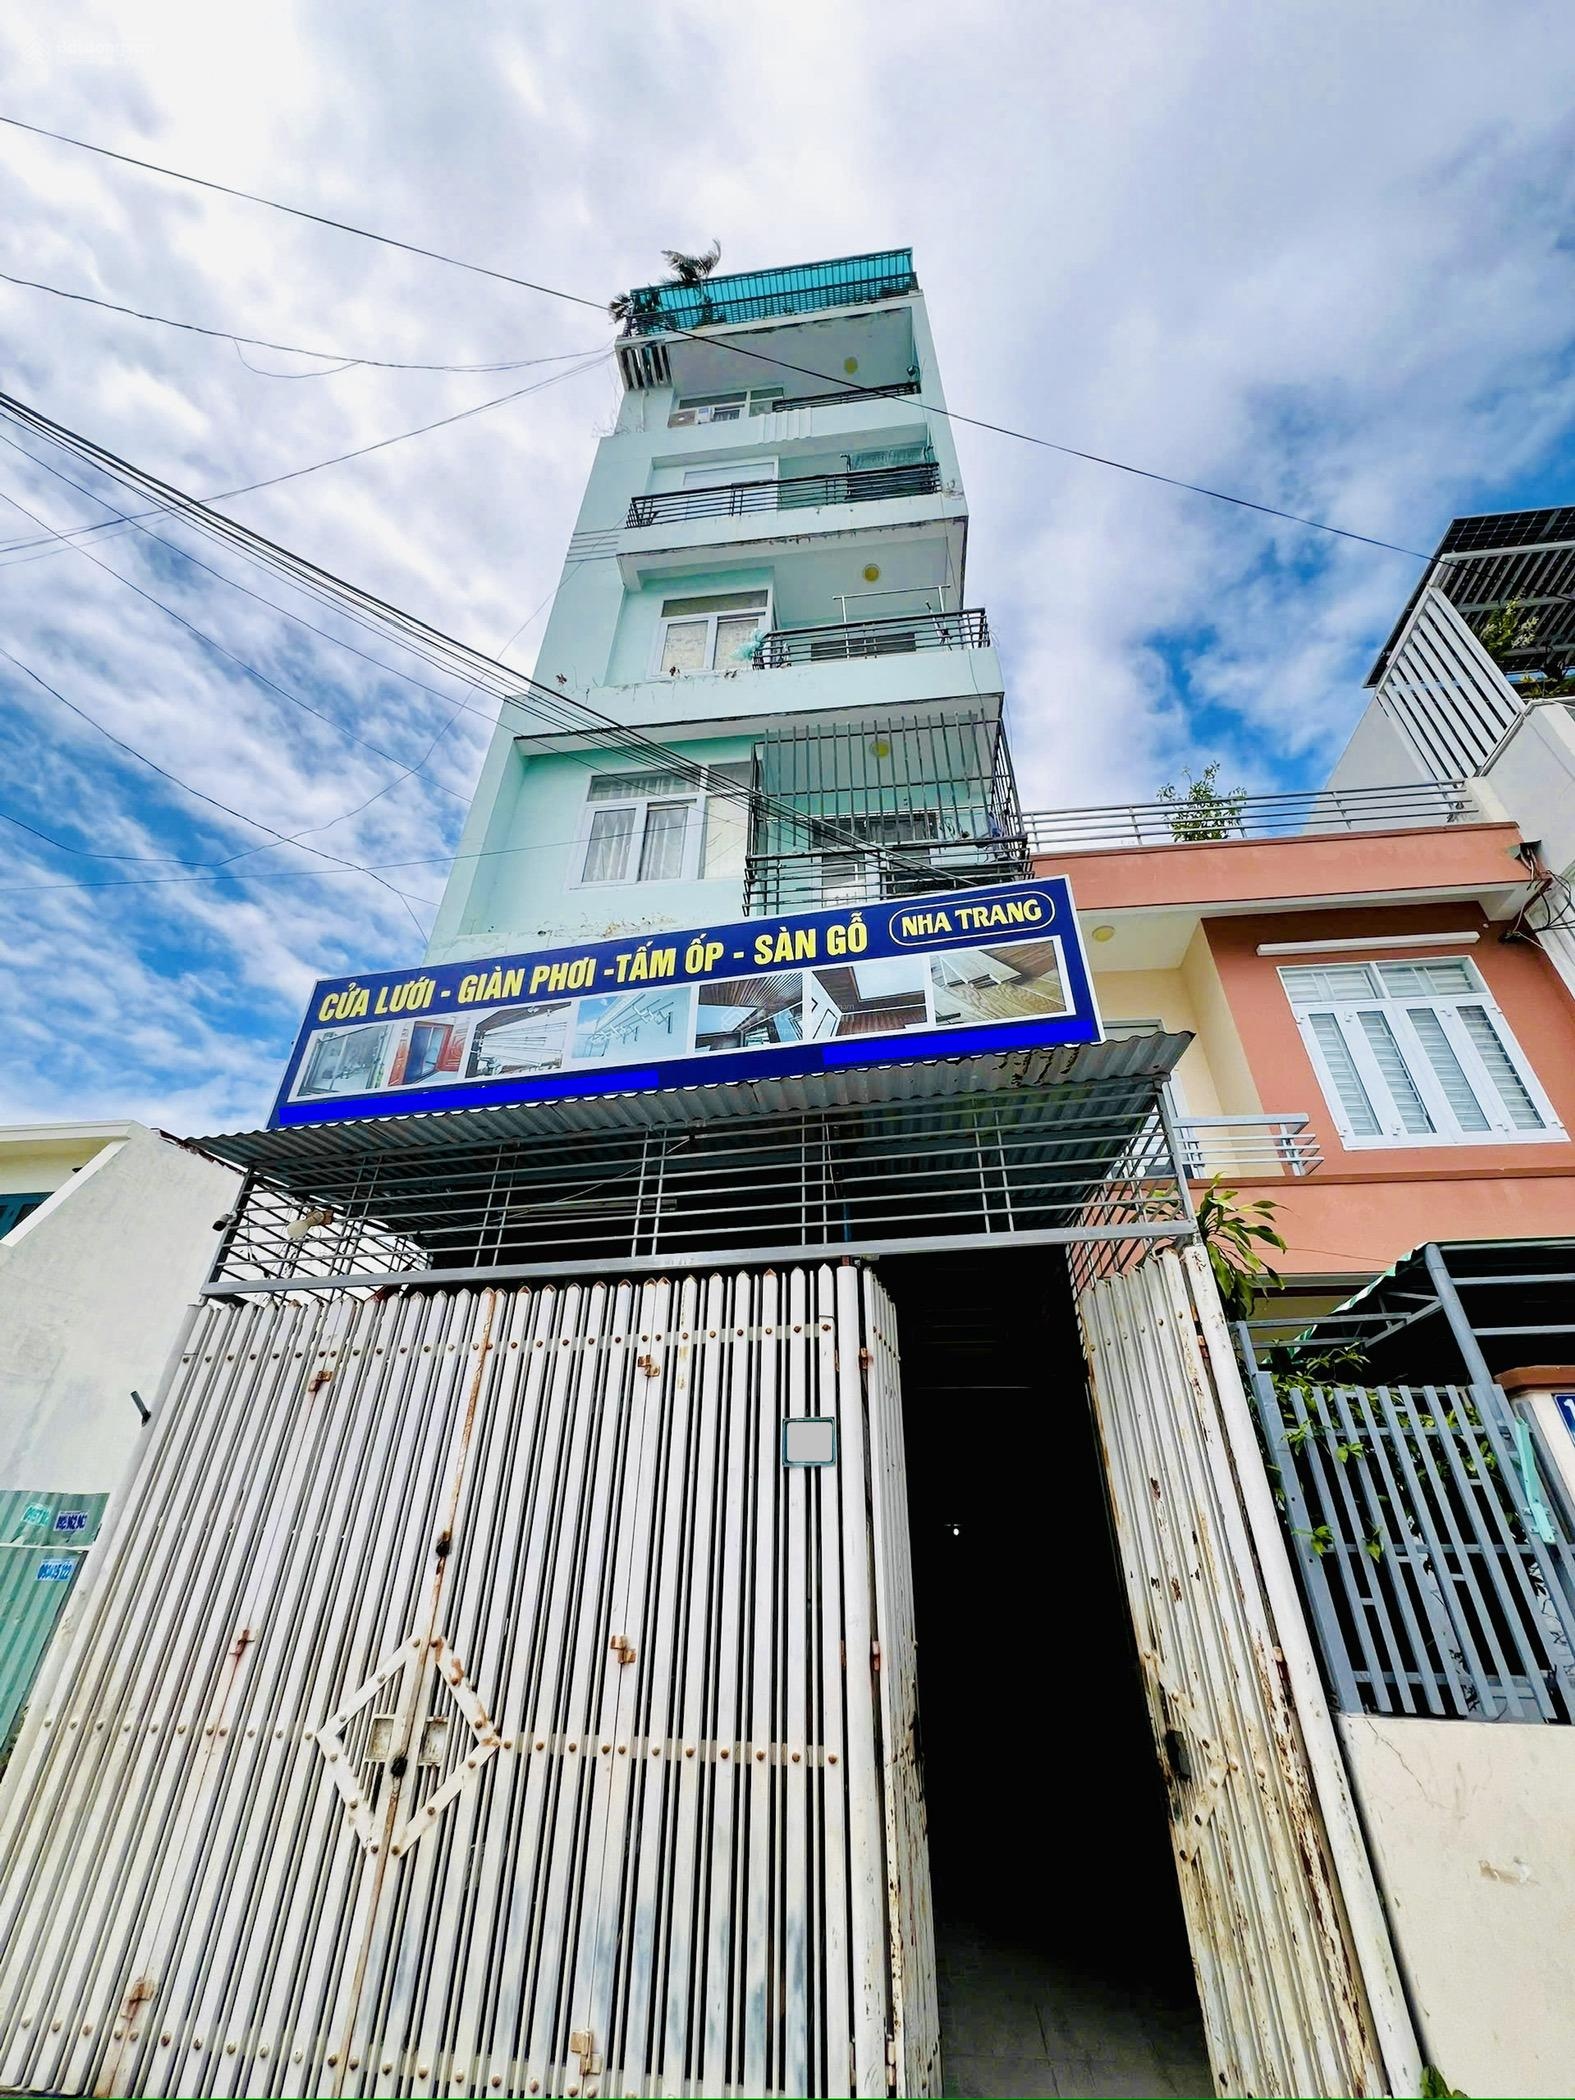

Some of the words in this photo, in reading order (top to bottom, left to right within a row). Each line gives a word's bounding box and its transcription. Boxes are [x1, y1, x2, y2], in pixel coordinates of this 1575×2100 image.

[901, 912, 953, 938] NHA
[955, 899, 1042, 931] TRANG
[318, 982, 369, 1022] CỬA
[374, 977, 436, 1015] LƯỚI
[458, 966, 526, 1004] GIÀN
[530, 958, 597, 995] PHƠI
[685, 933, 724, 974] ỐP
[754, 927, 817, 965] SÀN
[826, 911, 868, 956] GỖ
